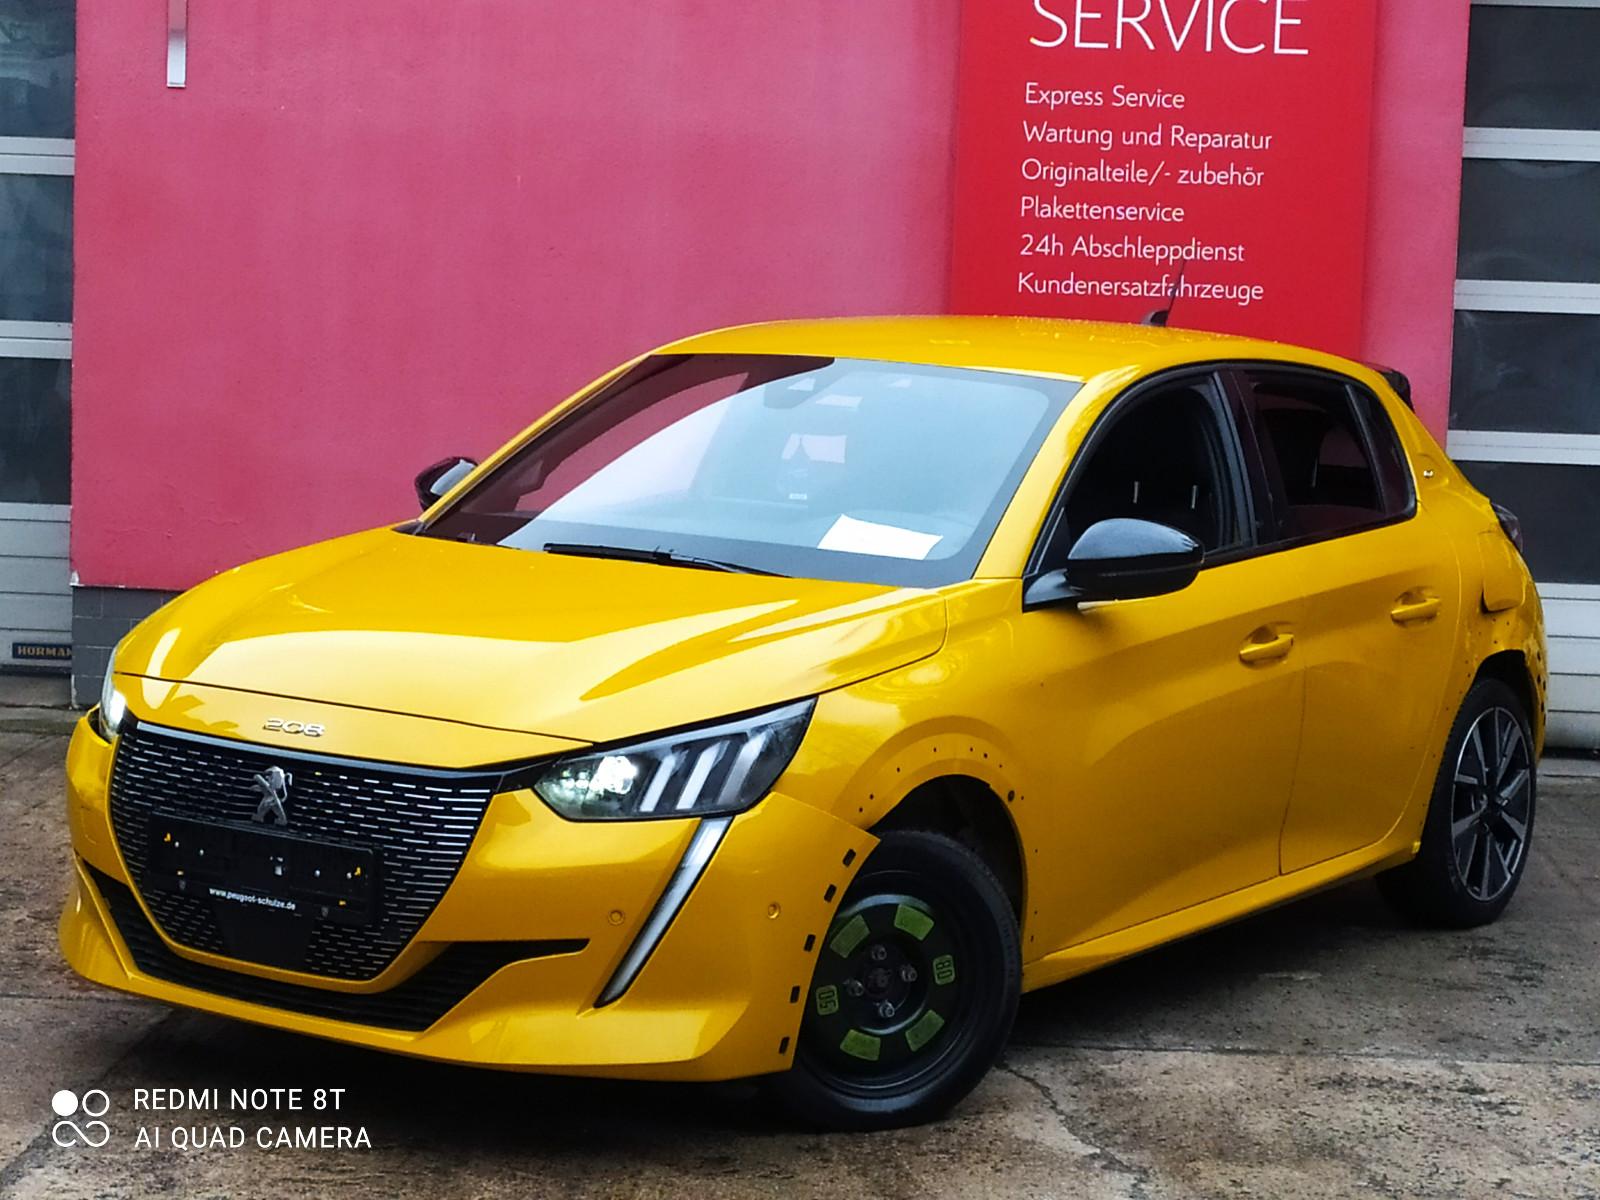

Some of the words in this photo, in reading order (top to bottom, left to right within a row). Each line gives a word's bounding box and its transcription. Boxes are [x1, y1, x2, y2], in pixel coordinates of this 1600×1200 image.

[1030, 0, 1309, 55] SERVICE
[1025, 81, 1104, 111] Express
[1111, 84, 1185, 109] Service
[1023, 120, 1113, 151] Wartung
[1122, 123, 1162, 146] und
[1171, 124, 1272, 154] Reparatur
[1022, 158, 1171, 188] Originalteile/-
[1177, 162, 1265, 187] zubehör
[1021, 195, 1185, 222] Plakettenservice
[1020, 233, 1064, 256] 24h
[1071, 234, 1244, 265] Abschleppdienst
[1018, 271, 1264, 306] Kundenersatzfahrzeuge
[262, 718, 325, 738] 208
[208, 887, 297, 911] www.peugeot-schulze.de
